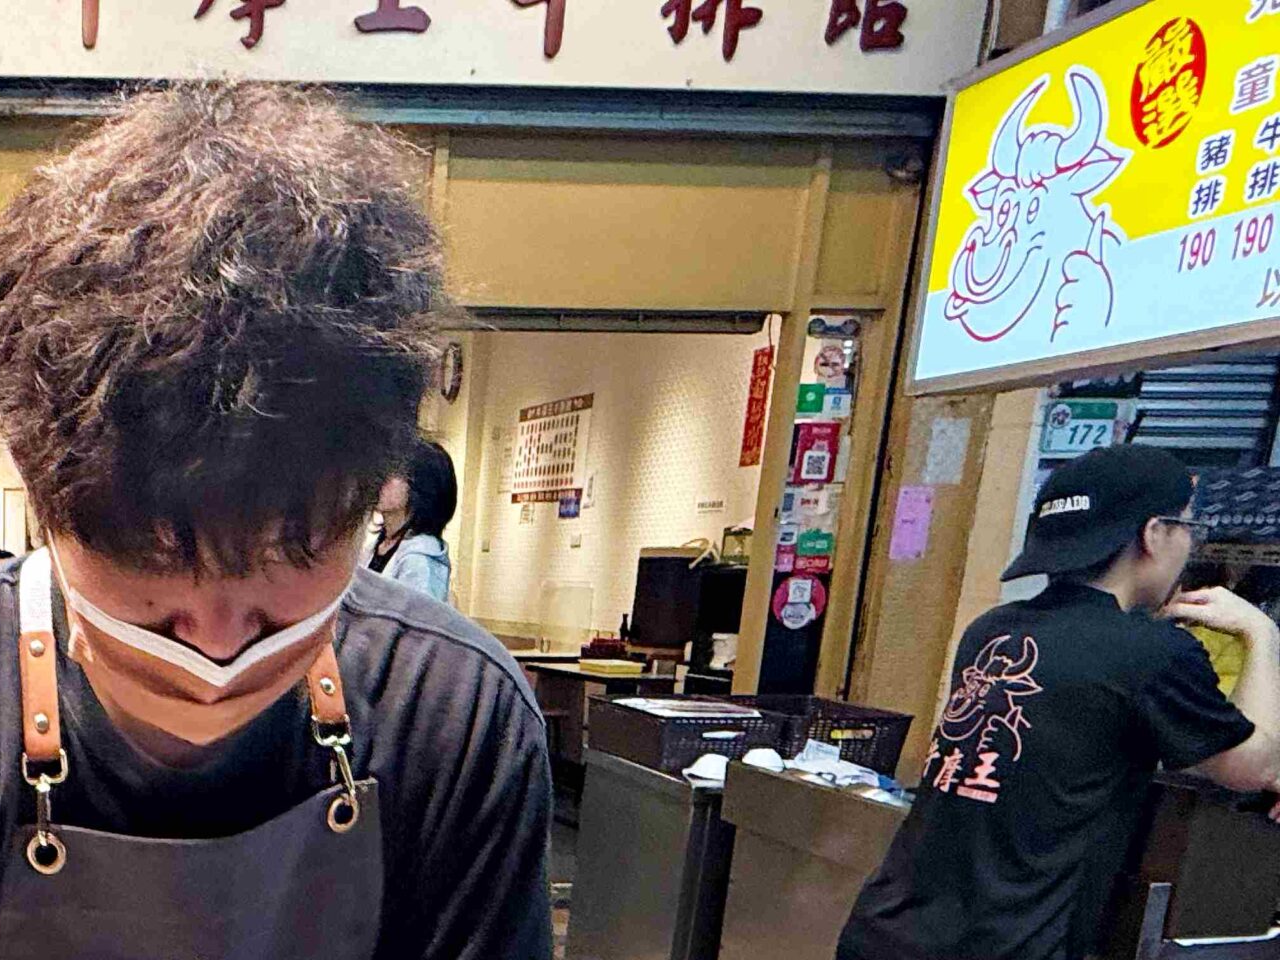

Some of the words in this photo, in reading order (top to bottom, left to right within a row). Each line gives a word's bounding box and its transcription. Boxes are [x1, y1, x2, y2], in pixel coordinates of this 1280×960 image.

[1187, 134, 1232, 215] 豬排
[1178, 228, 1216, 273] 190
[1232, 213, 1273, 260] 190
[1068, 424, 1108, 445] 172
